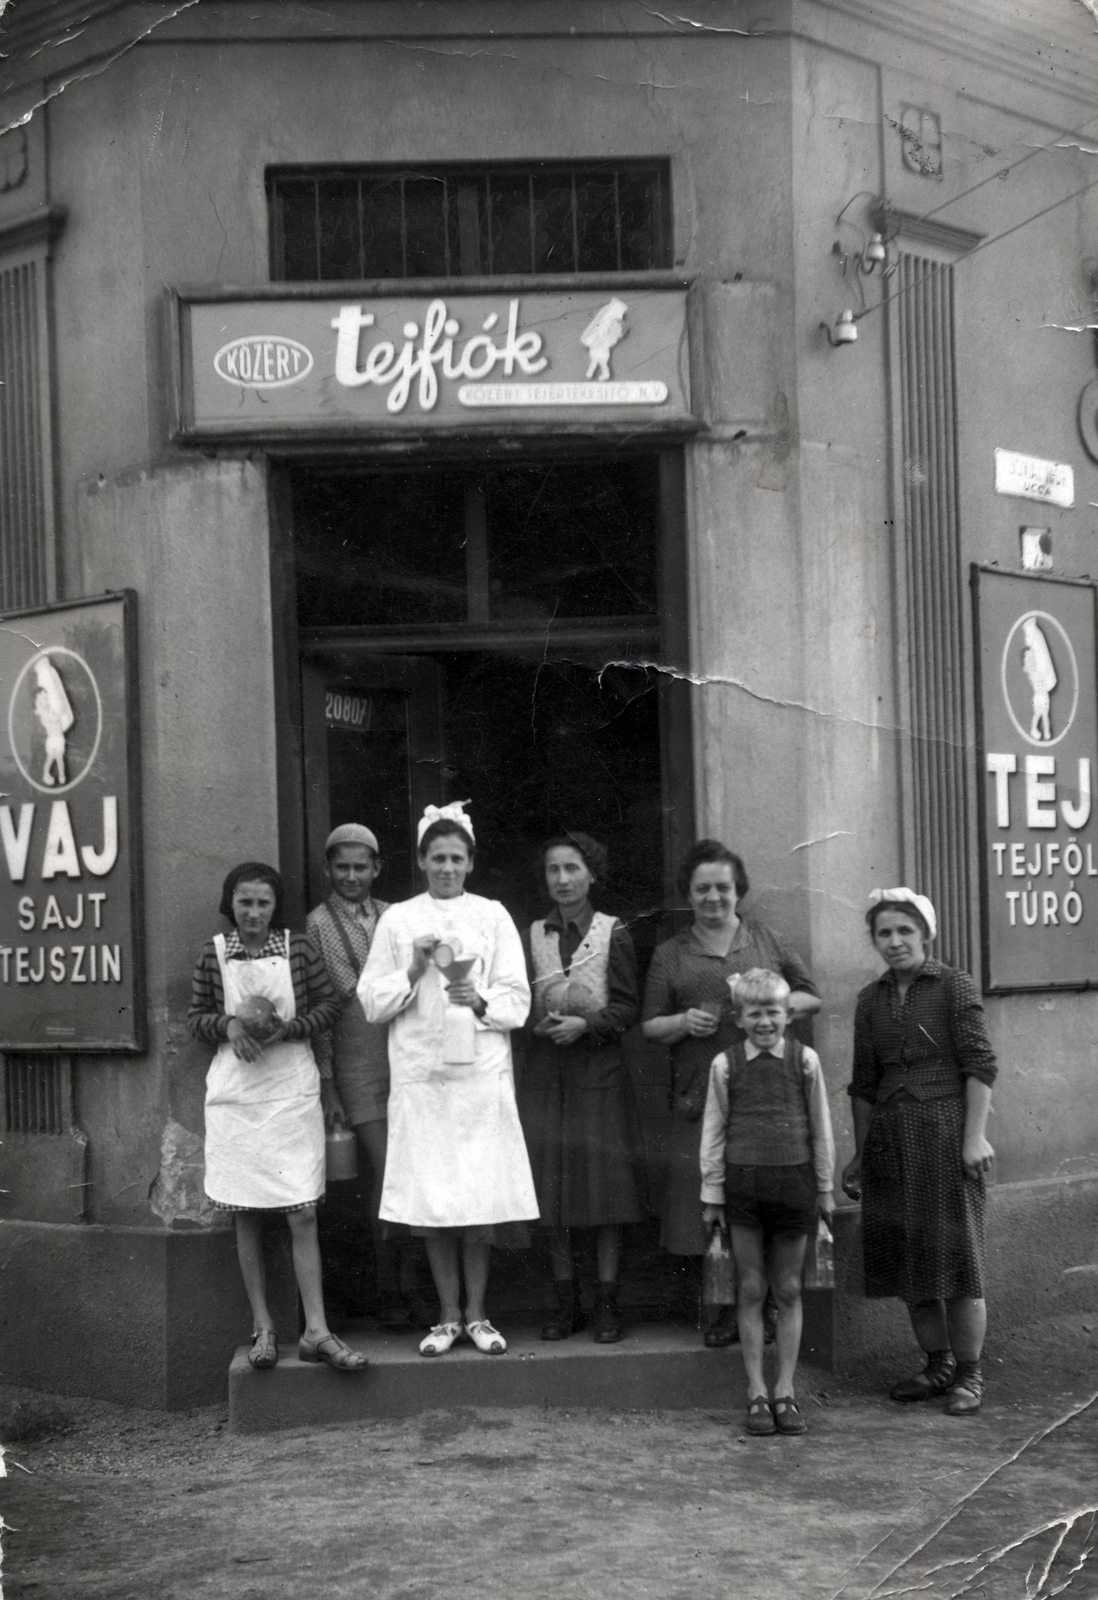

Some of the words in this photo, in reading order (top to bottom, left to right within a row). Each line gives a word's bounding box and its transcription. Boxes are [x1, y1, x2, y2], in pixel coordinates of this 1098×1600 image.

[226, 341, 302, 381] KÖZÉRT
[331, 298, 547, 412] tejfiók
[325, 692, 368, 725] 20807
[986, 753, 1091, 829] TEJ
[0, 796, 118, 881] VAJ
[18, 893, 106, 931] SAJT
[1005, 880, 1083, 926] TÚRÓ
[0, 944, 121, 984] TEJSZIN
